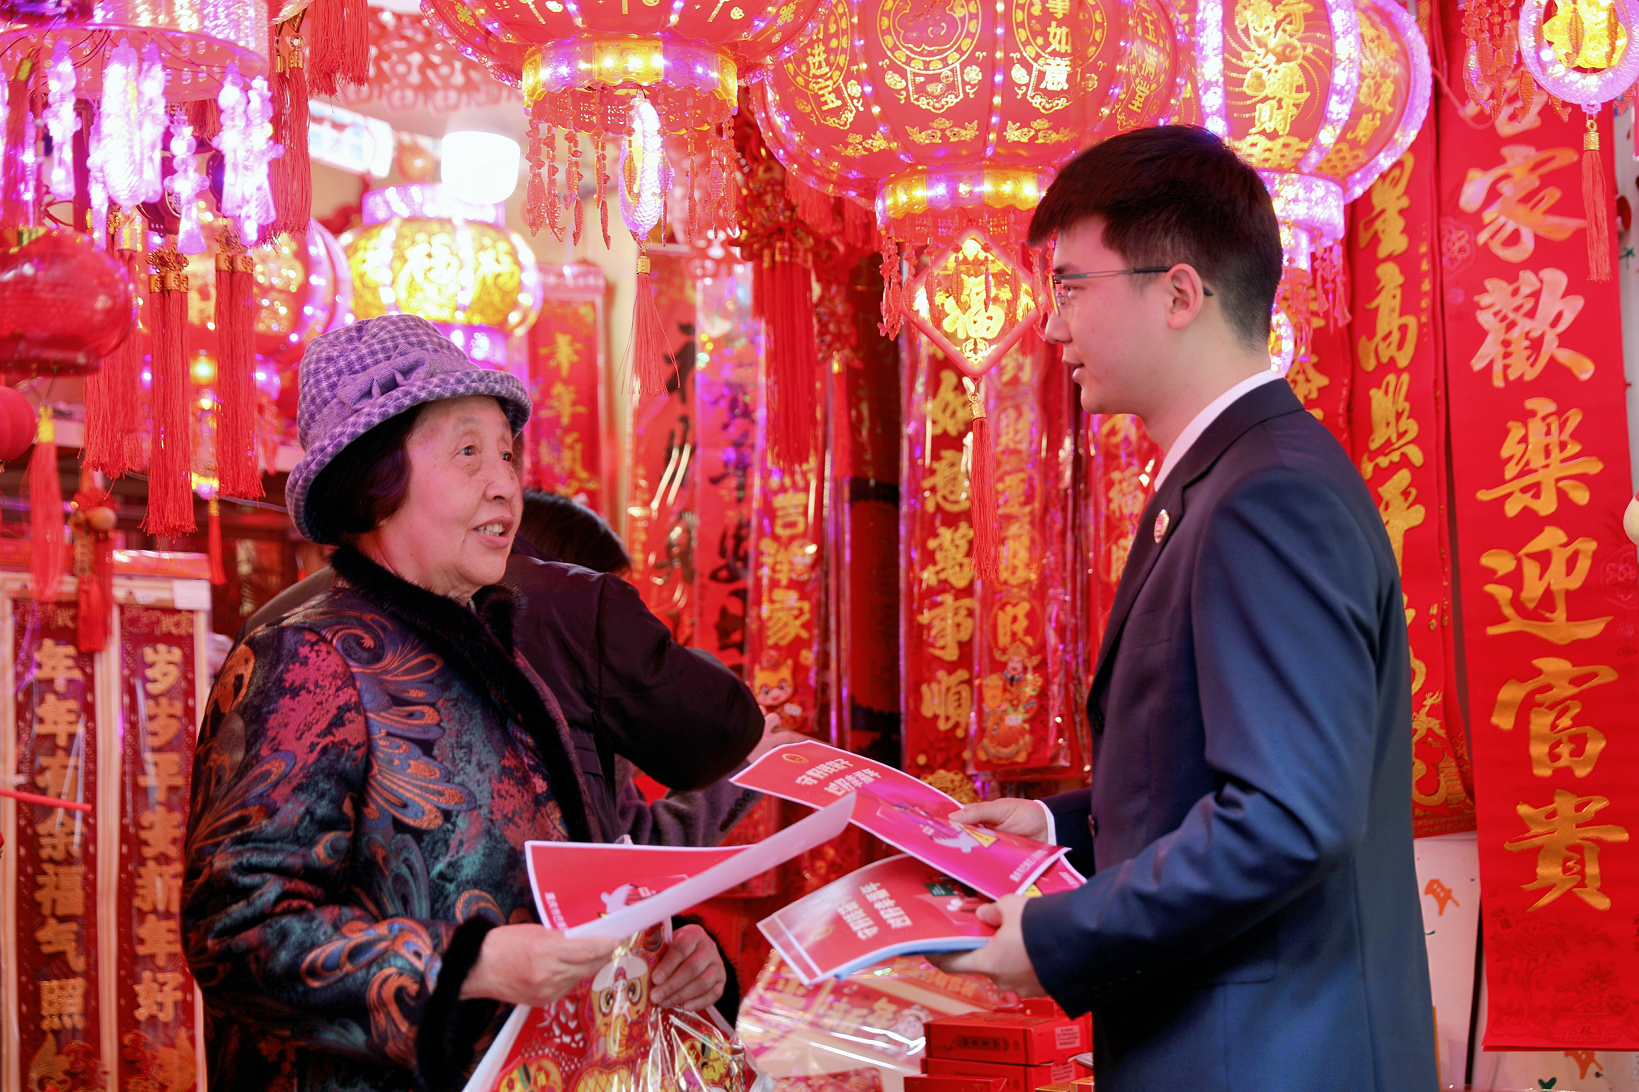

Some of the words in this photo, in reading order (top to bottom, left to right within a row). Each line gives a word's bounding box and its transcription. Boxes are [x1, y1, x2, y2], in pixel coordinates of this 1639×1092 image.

[1128, 0, 1158, 113] 玉满堂
[942, 273, 1006, 340] 福
[757, 465, 815, 647] 吉祥家
[917, 340, 975, 738] 如意萬事順
[823, 768, 881, 797] 过好幸福年
[836, 896, 879, 941] 守好钱袋
